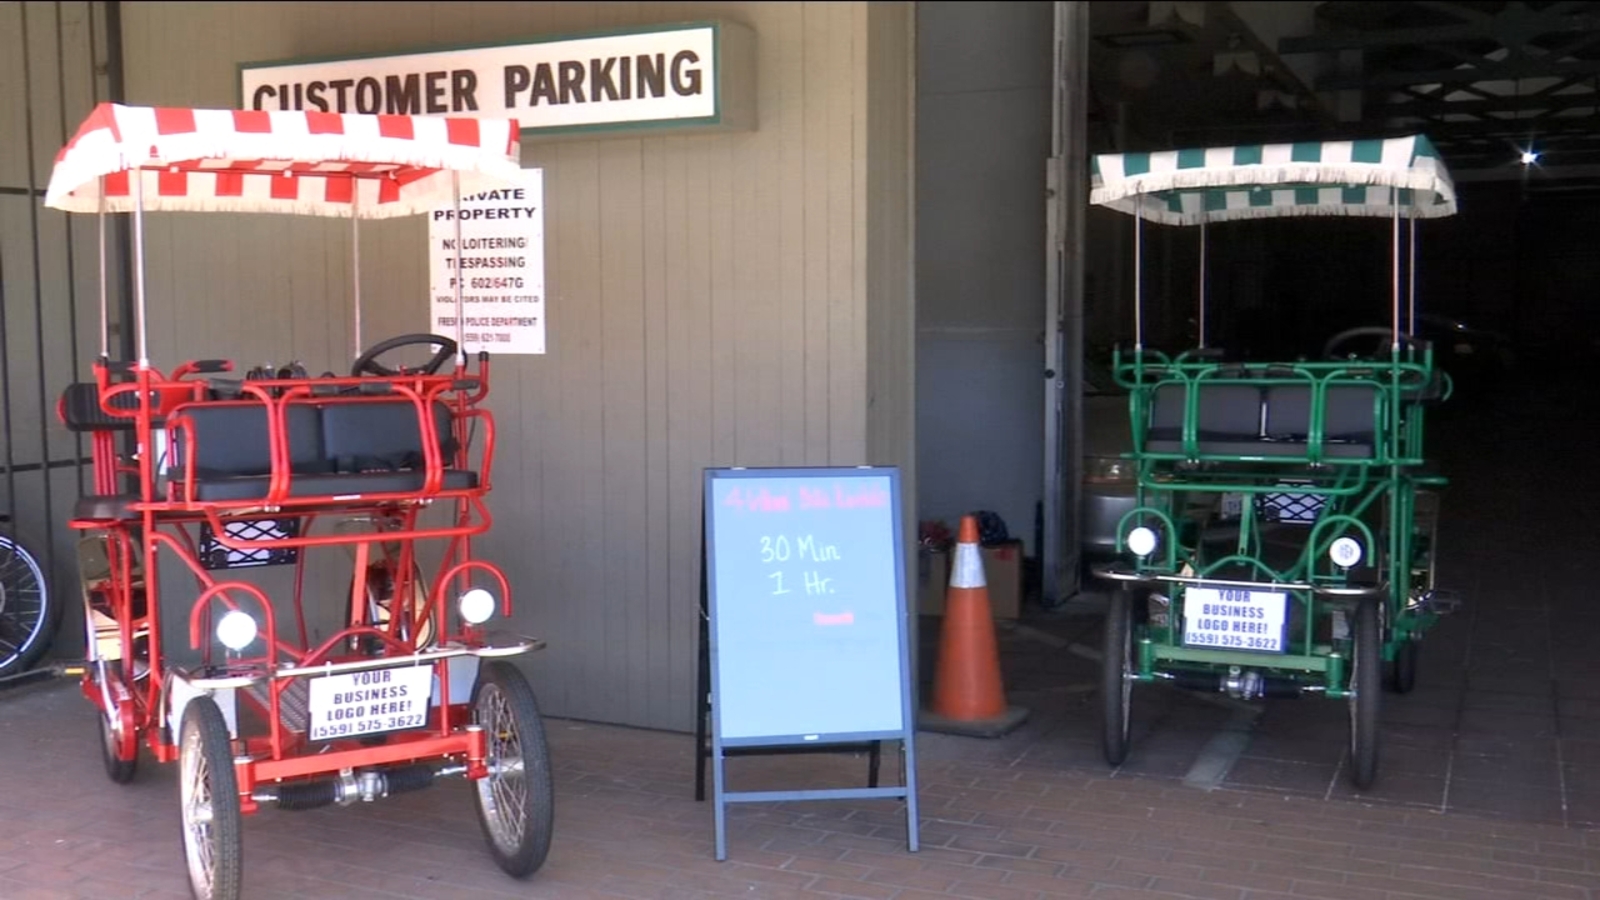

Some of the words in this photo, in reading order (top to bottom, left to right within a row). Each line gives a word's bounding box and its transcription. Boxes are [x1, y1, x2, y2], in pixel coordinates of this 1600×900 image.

[252, 69, 479, 115] CUSTOMER
[504, 49, 702, 109] PARKING
[461, 188, 525, 201] IVATE
[434, 207, 536, 221] PROPERTY
[466, 317, 490, 327] POLICE
[760, 534, 791, 562] 30
[797, 534, 841, 562] Min
[768, 570, 791, 595] 1
[803, 570, 836, 595] Hr.
[1219, 589, 1251, 602] YOUR
[1203, 604, 1264, 619] BUSINESS
[1197, 619, 1229, 631] LOGO
[1232, 621, 1268, 634] HERE!
[1222, 634, 1277, 649] 575-3622
[352, 670, 391, 686] YOUR
[334, 685, 408, 705] BUSINESS
[327, 706, 365, 721] LOGO
[370, 700, 412, 715] HERE!
[358, 714, 422, 732] 575-3622
